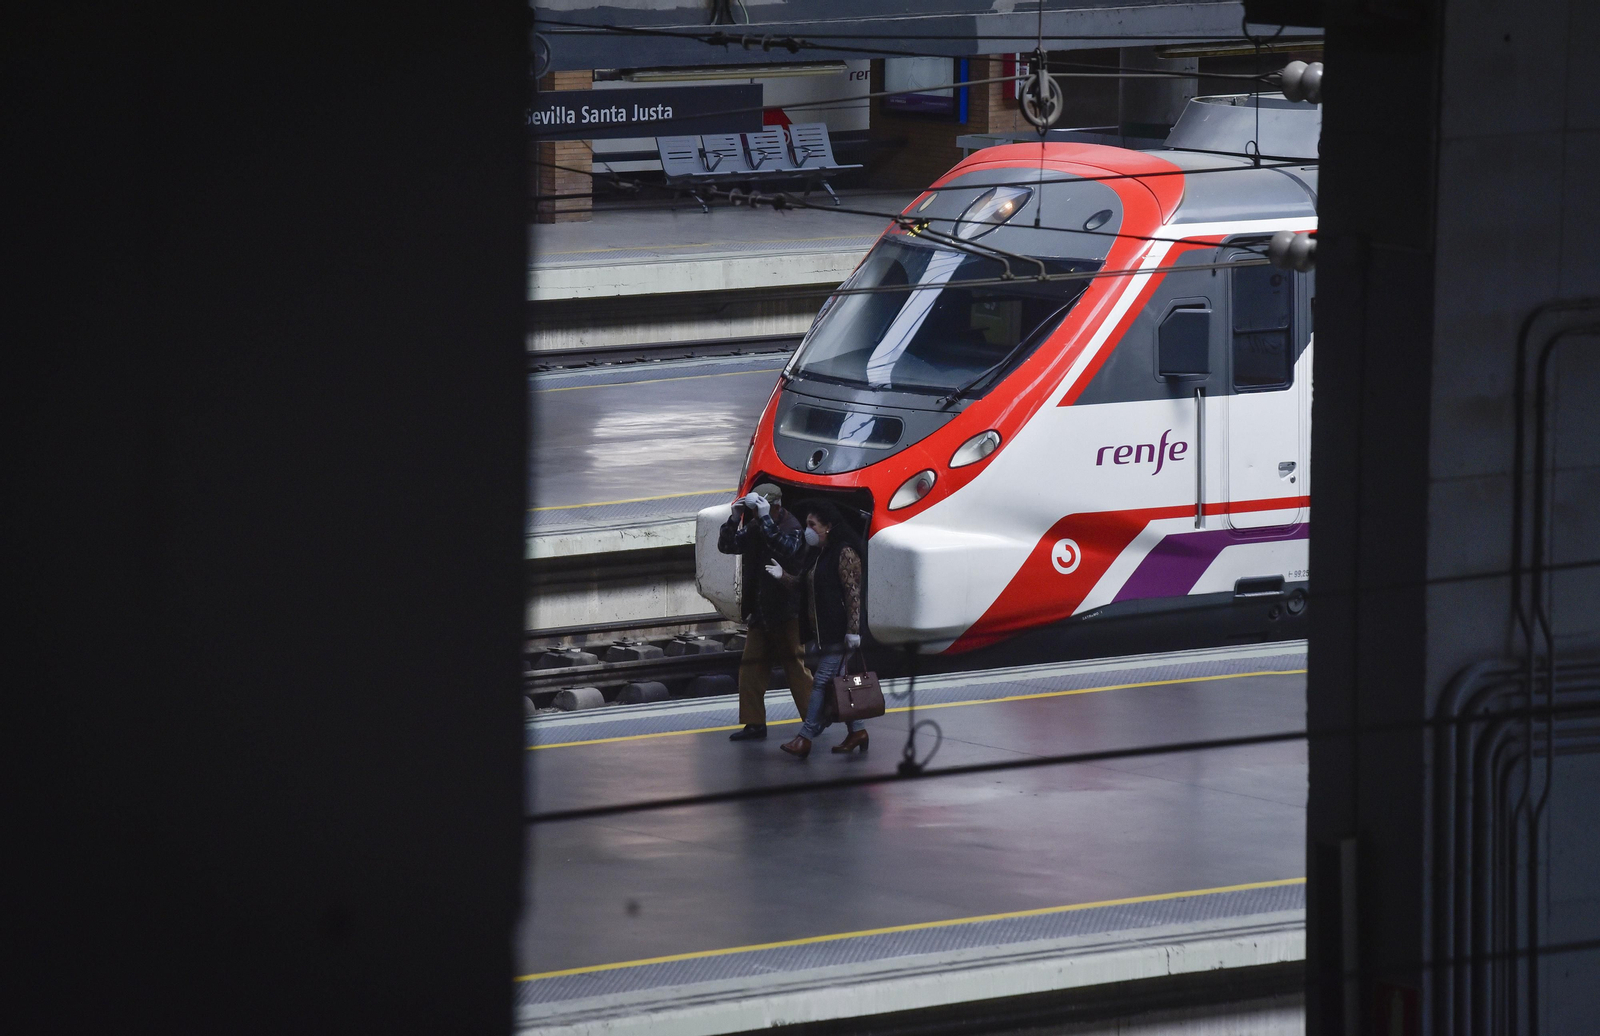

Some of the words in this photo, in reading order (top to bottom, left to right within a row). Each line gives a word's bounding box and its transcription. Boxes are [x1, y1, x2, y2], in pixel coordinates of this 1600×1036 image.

[581, 105, 626, 123] Santa
[631, 103, 673, 122] Justa
[1096, 429, 1188, 476] renfe
